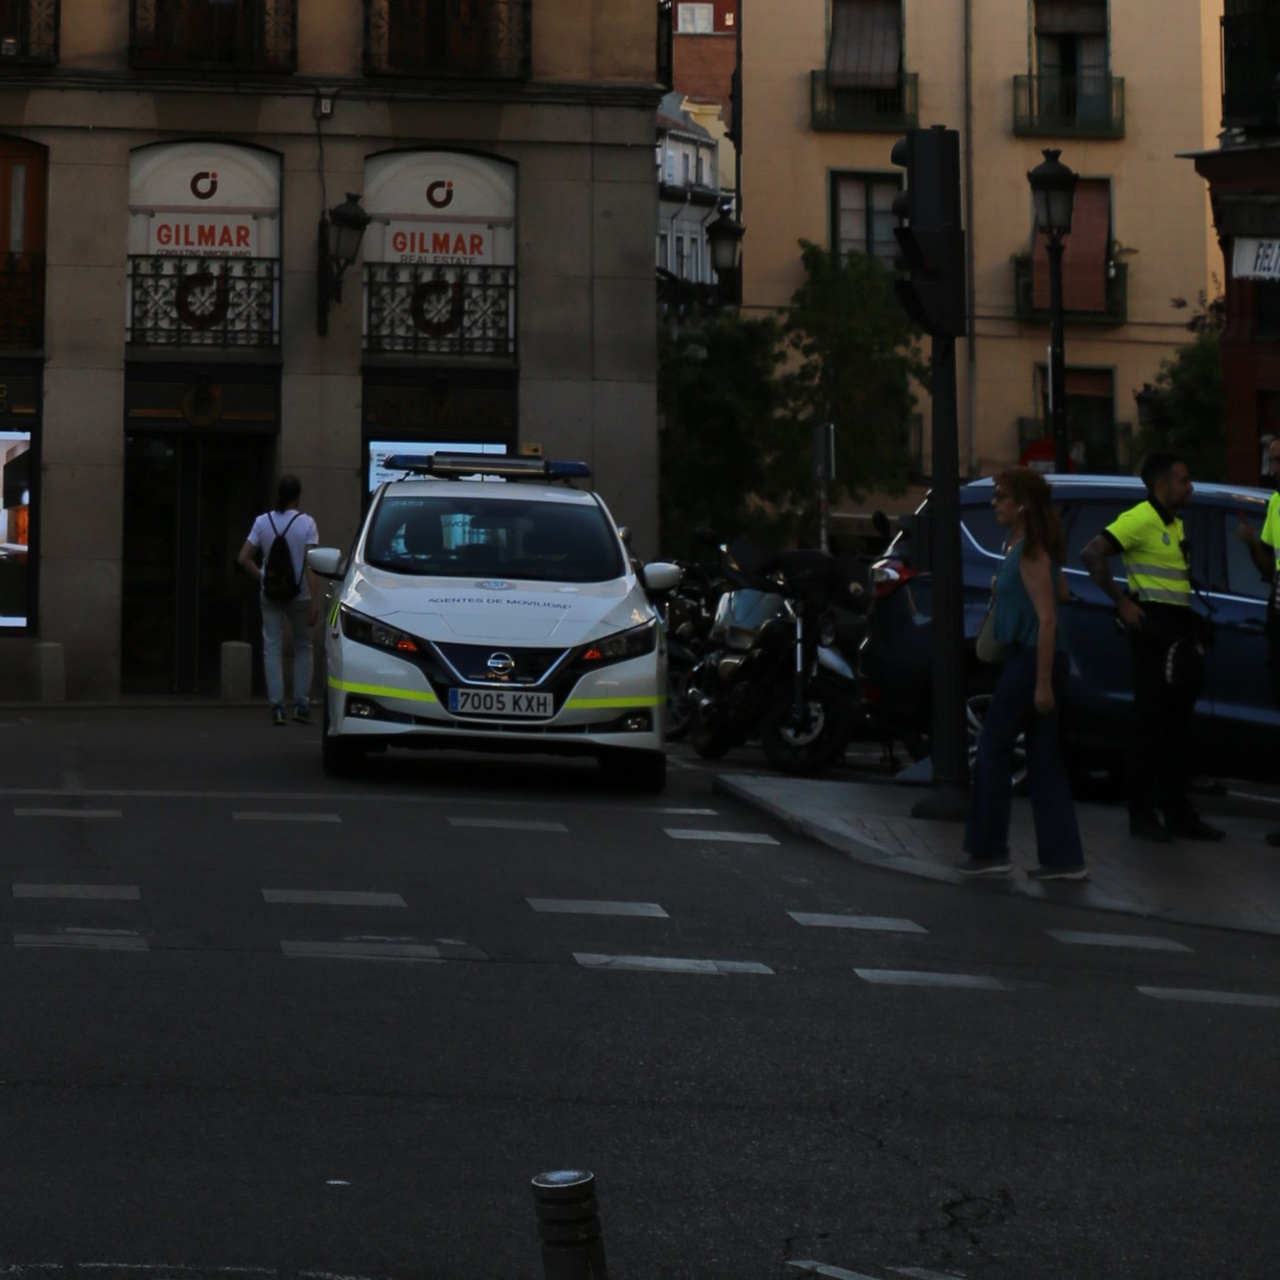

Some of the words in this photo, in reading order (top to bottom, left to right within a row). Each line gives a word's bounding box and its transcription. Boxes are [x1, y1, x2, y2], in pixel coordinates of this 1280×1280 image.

[157, 224, 251, 247] GILMAR
[392, 231, 484, 256] GILMAR
[400, 254, 429, 265] REAL
[434, 256, 477, 266] ESTATE
[506, 599, 572, 609] MOVILIDAD
[460, 692, 506, 711] 7005
[512, 694, 548, 713] KXH
